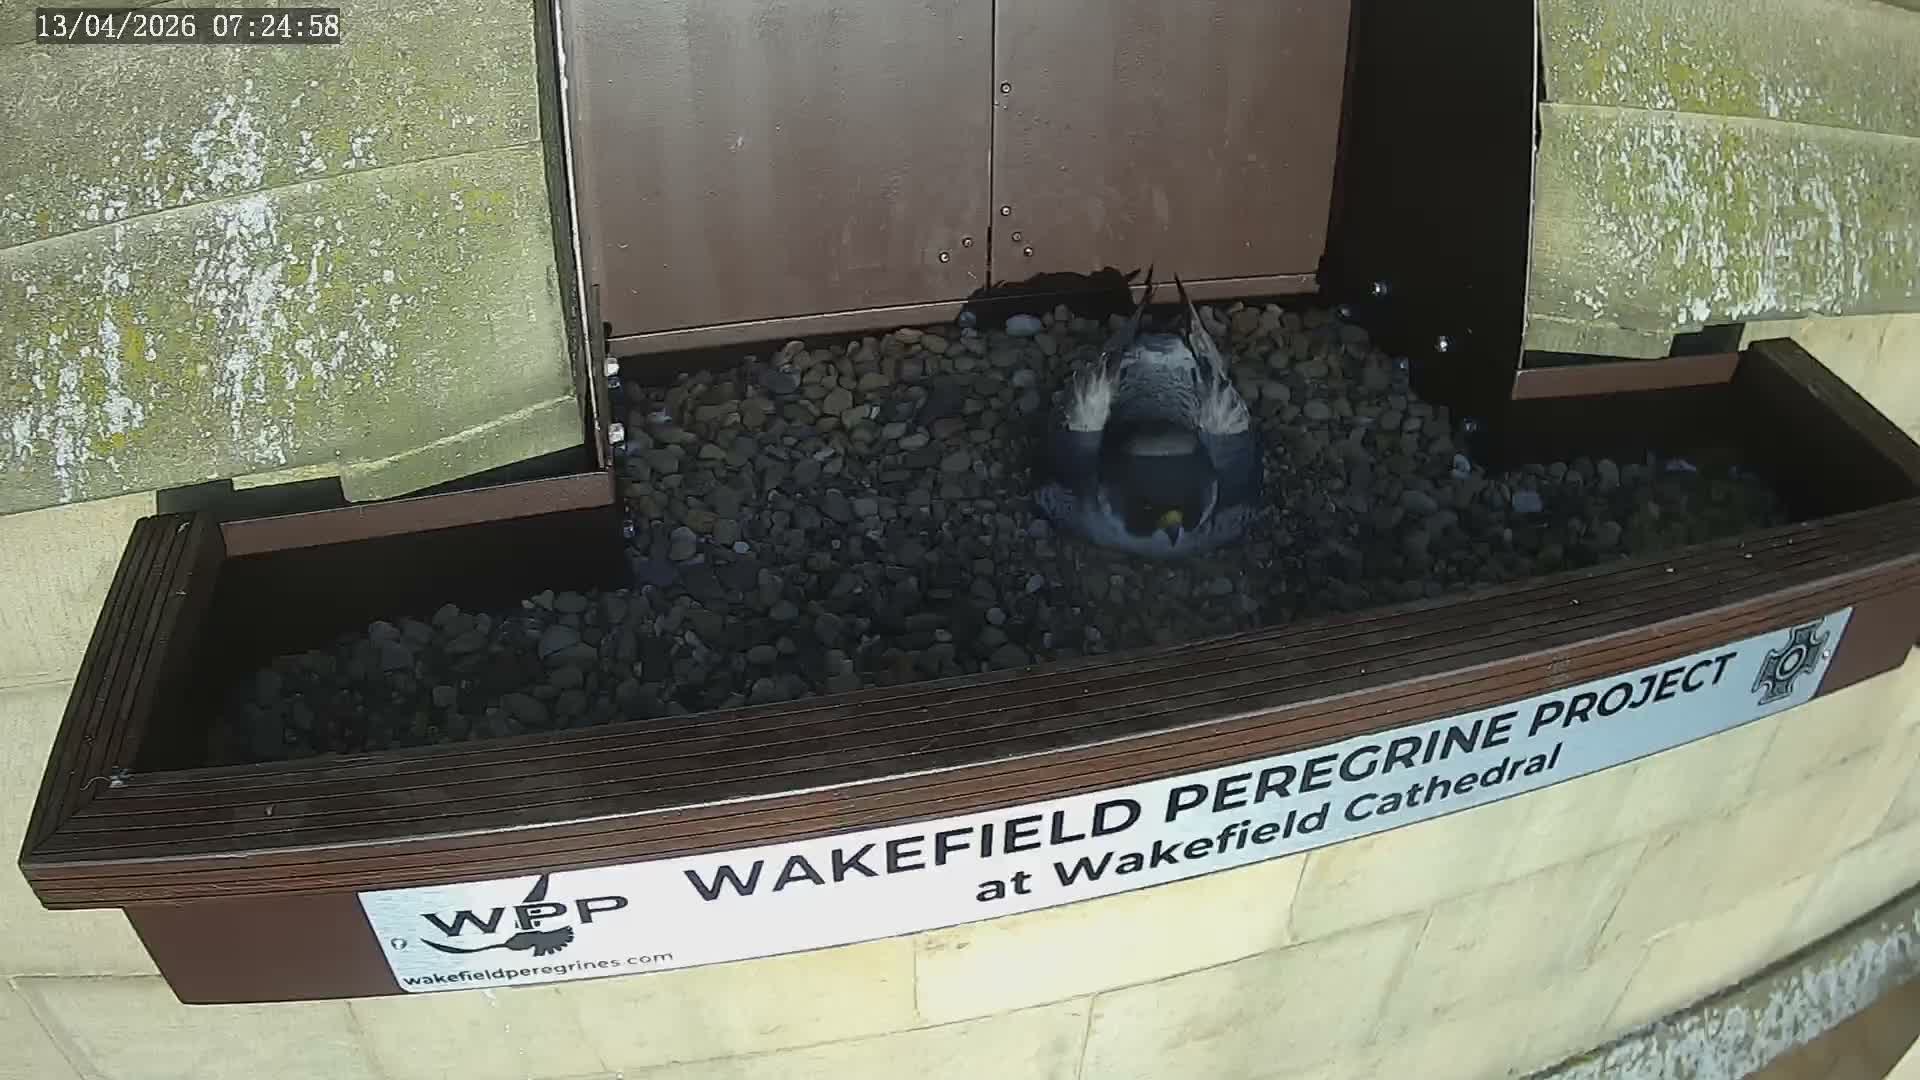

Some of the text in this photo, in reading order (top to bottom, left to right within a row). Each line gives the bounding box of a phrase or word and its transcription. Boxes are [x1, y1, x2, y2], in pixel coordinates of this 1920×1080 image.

[684, 651, 1738, 901] WAKEFIELD PEREGRINE PROJECT
[976, 742, 1562, 901] at Wakefield Cathedral
[420, 894, 629, 937] WPP
